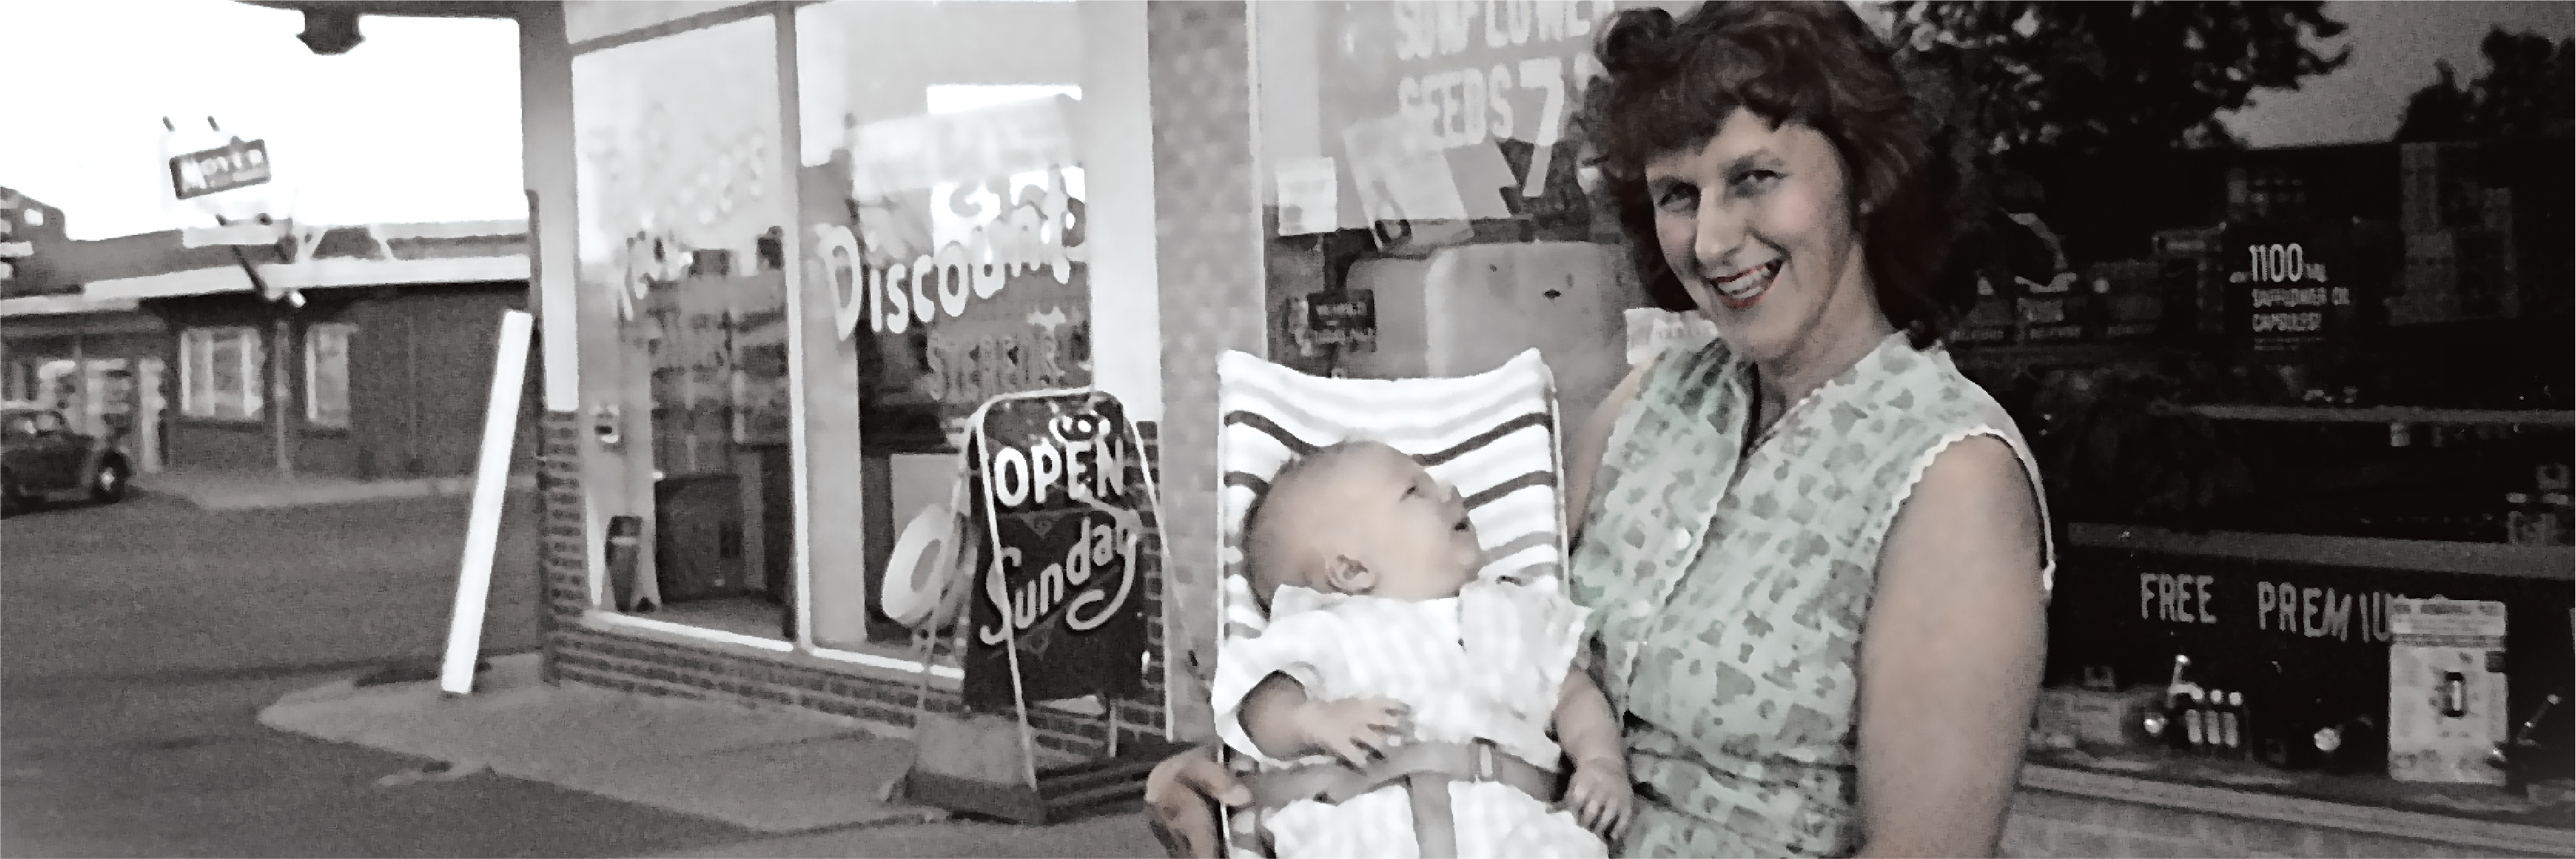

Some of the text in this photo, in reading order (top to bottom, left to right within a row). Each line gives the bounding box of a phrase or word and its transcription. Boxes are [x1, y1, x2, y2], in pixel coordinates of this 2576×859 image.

[1398, 65, 1514, 152] SEEDS
[2248, 242, 2303, 283] 1100
[994, 437, 1124, 507] OPEN
[979, 514, 1138, 645] Sunday
[2140, 572, 2404, 643] FREE PREMIU
